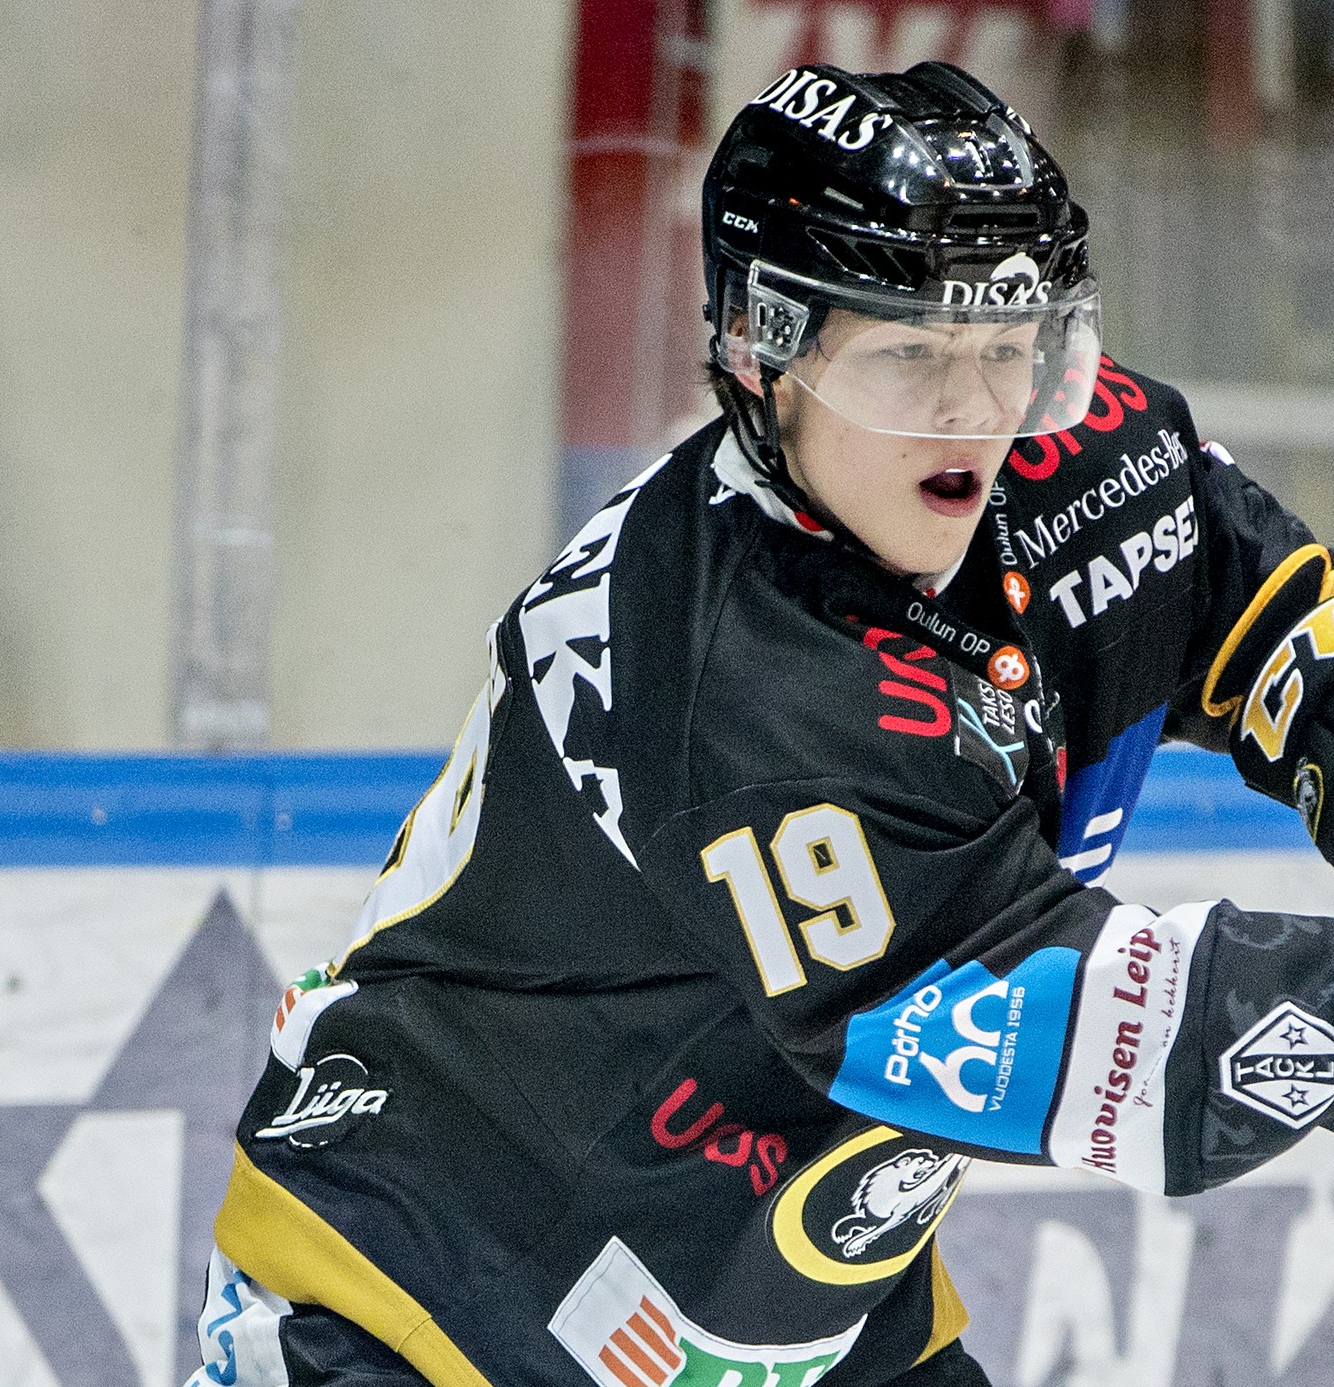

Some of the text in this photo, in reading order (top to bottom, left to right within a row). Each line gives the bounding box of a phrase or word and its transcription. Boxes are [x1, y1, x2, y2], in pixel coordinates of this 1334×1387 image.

[750, 69, 893, 151] DISAS
[721, 210, 759, 233] CCM
[941, 279, 1053, 309] DISAS
[995, 513, 1018, 566] Oulun
[907, 601, 991, 656] Oulun OP
[700, 802, 896, 998] 19
[987, 985, 1026, 1111] VUODESTA 1956
[255, 1067, 389, 1139] Liiga
[1080, 1020, 1144, 1175] Huovisen
